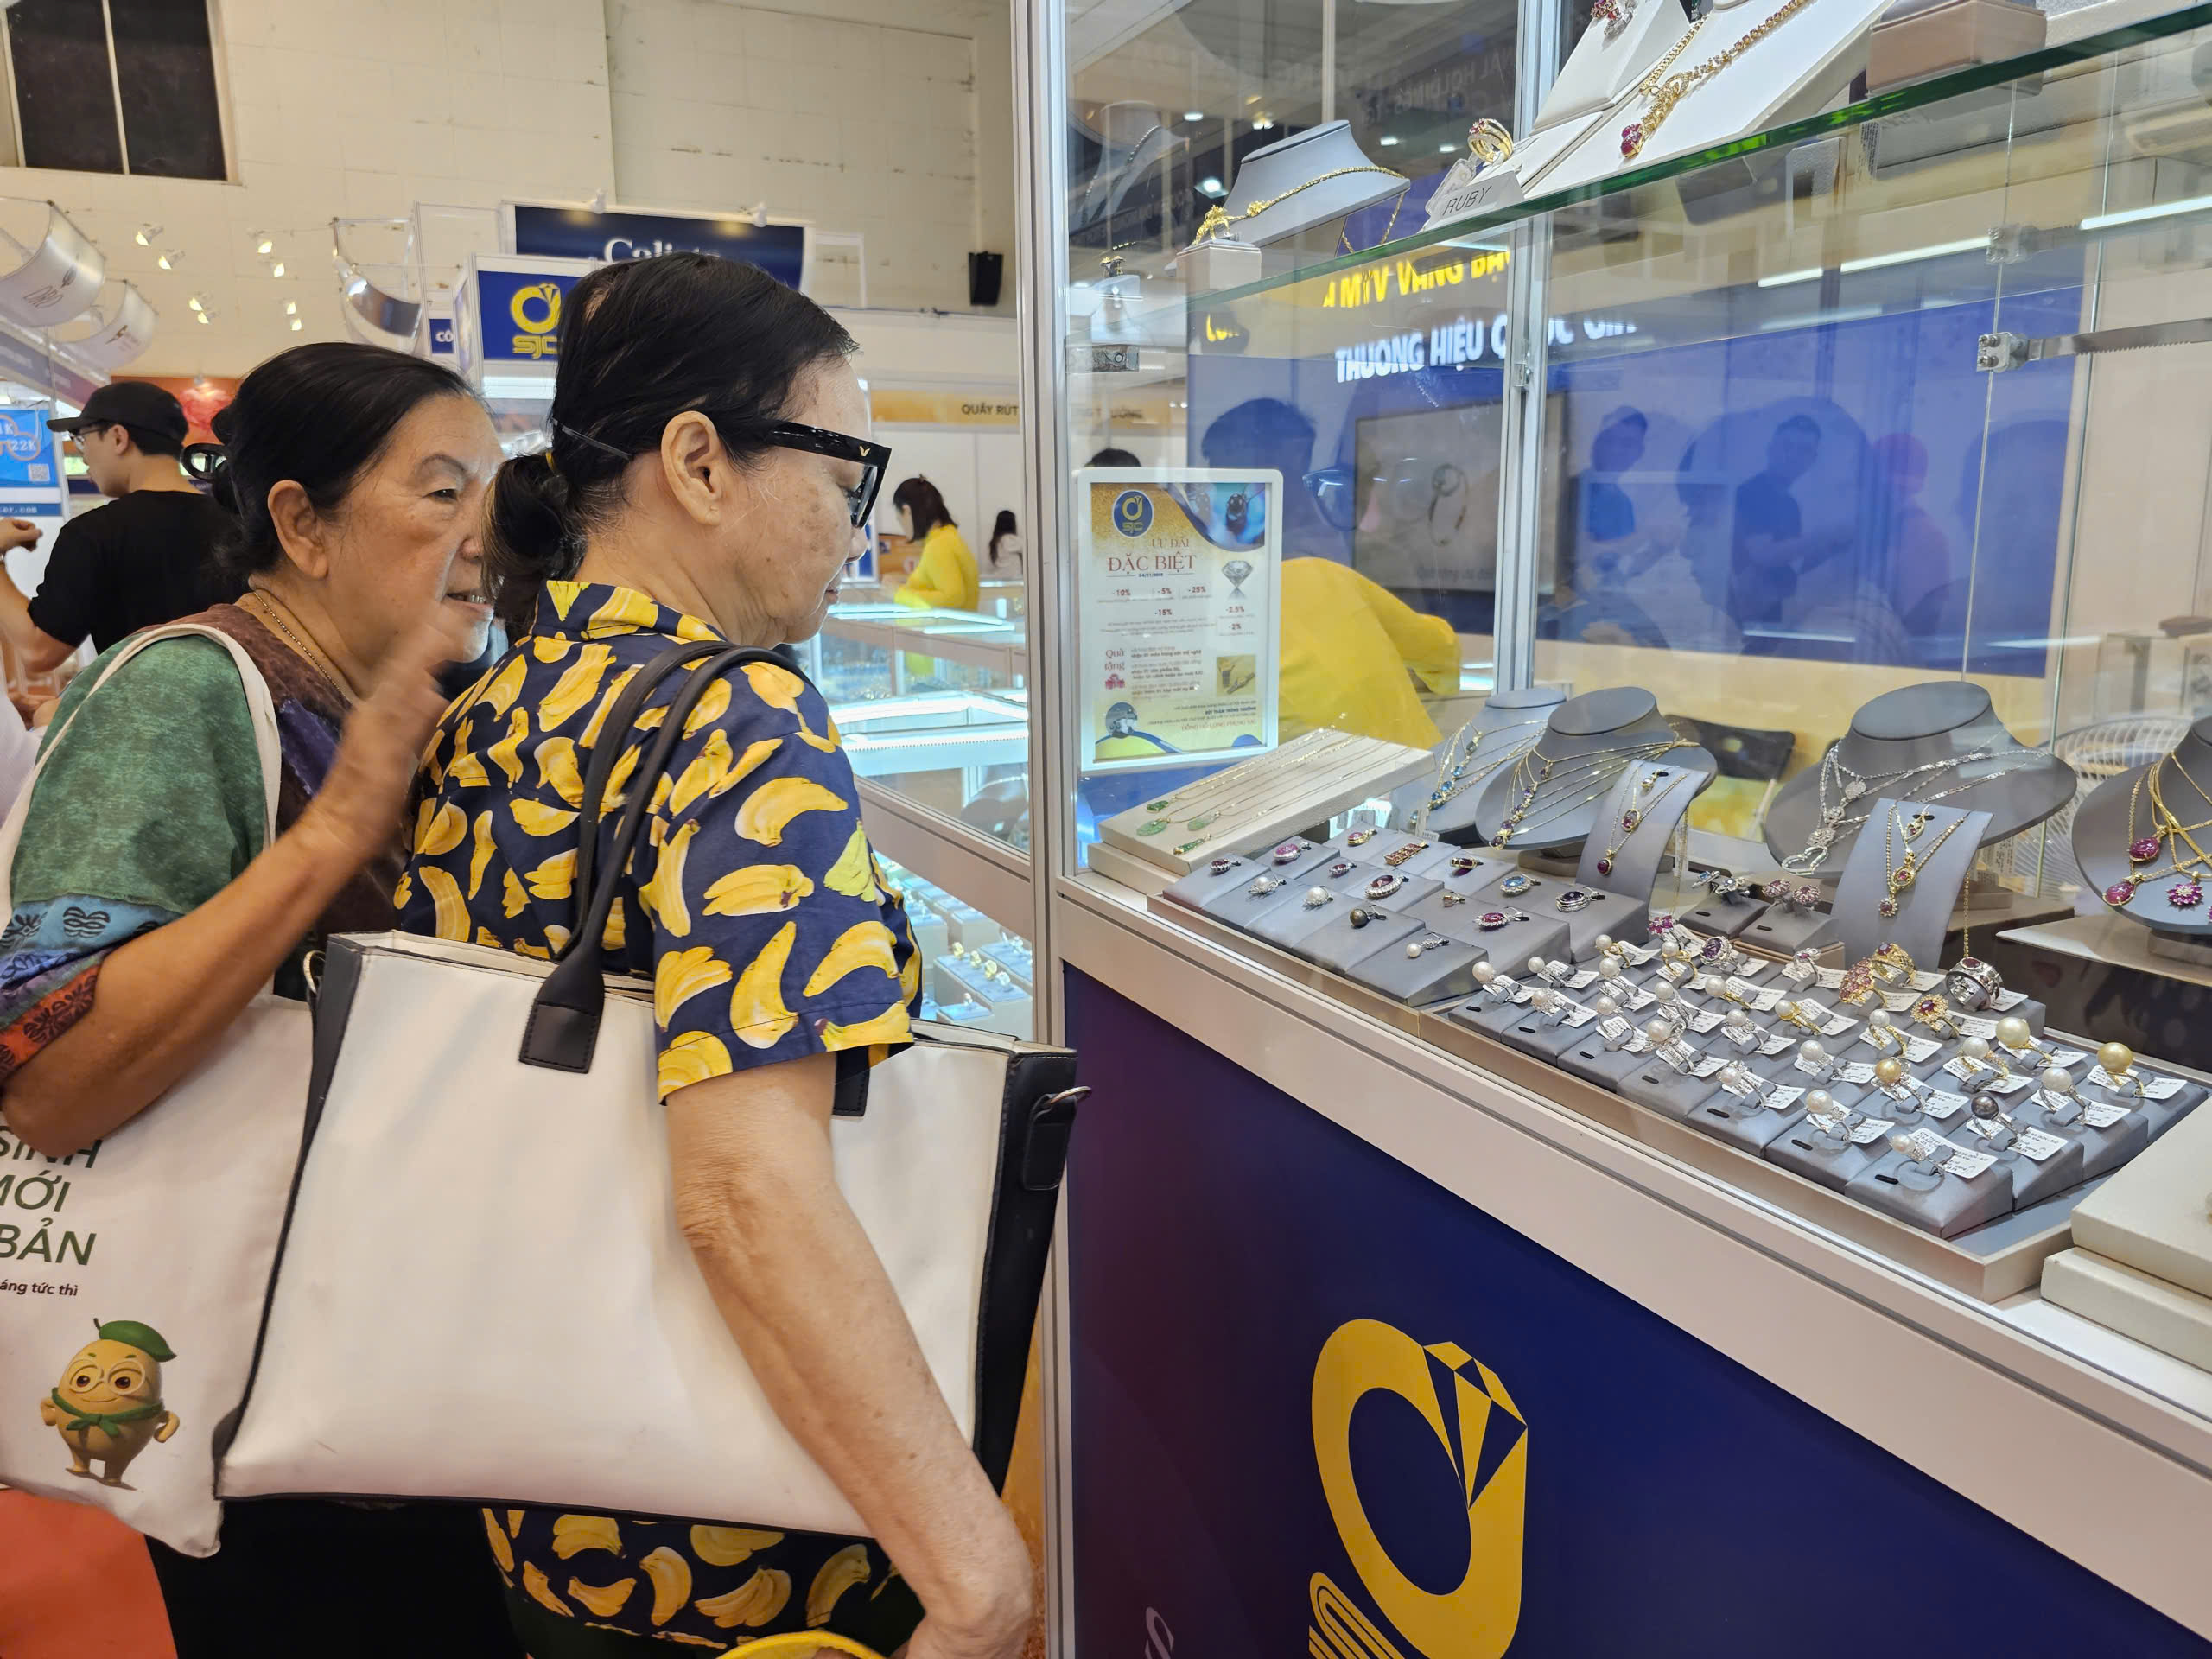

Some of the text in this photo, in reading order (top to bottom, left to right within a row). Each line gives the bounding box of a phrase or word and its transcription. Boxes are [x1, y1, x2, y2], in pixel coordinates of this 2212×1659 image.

[1442, 185, 1493, 217] RUBY
[512, 334, 559, 359] SJC
[1429, 315, 1484, 372] HIỆU
[11, 438, 37, 452] 22K
[1108, 551, 1197, 574] ĐẶC BIỆT
[0, 1217, 98, 1266] BẢN
[32, 1281, 56, 1294] tức
[59, 1284, 79, 1296] thì
